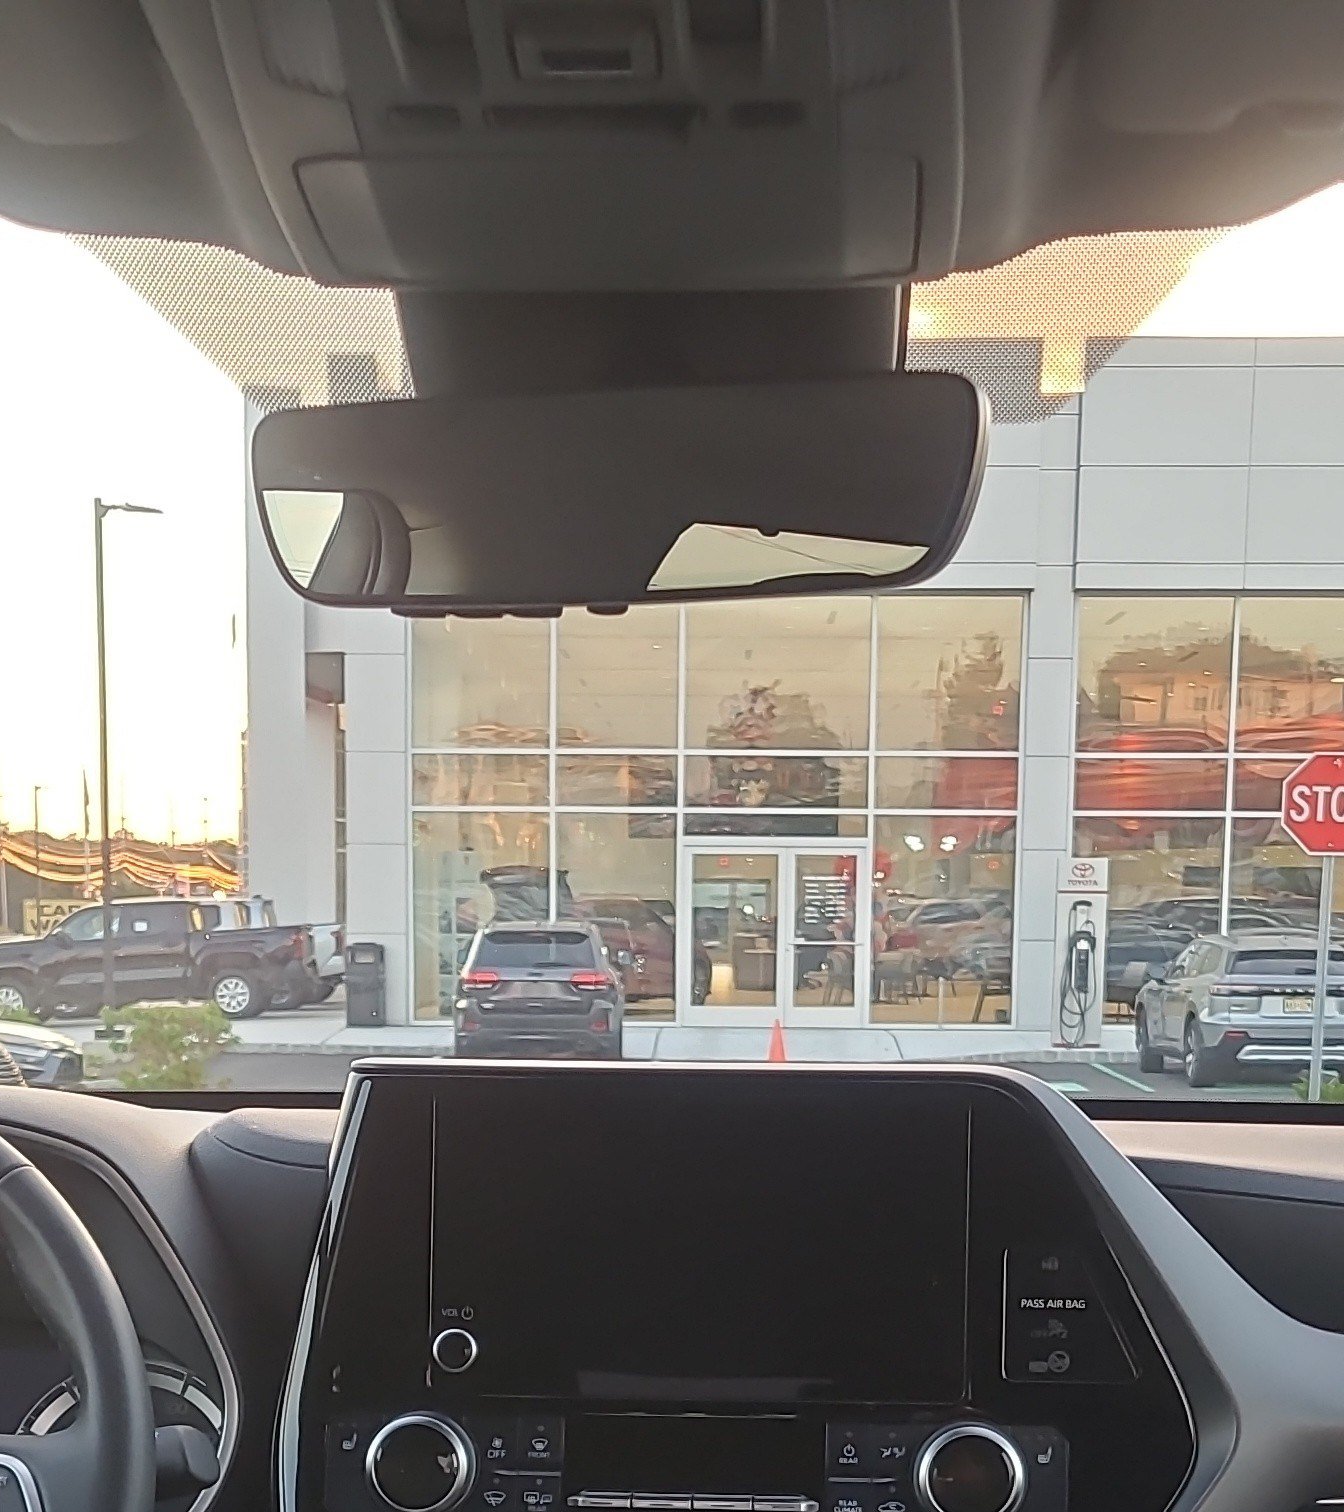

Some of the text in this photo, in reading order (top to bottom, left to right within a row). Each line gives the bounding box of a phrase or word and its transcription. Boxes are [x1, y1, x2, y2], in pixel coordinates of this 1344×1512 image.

[1021, 1299, 1086, 1309] PASS AIR BAG
[441, 1308, 458, 1317] VOL
[487, 1449, 506, 1459] OFF
